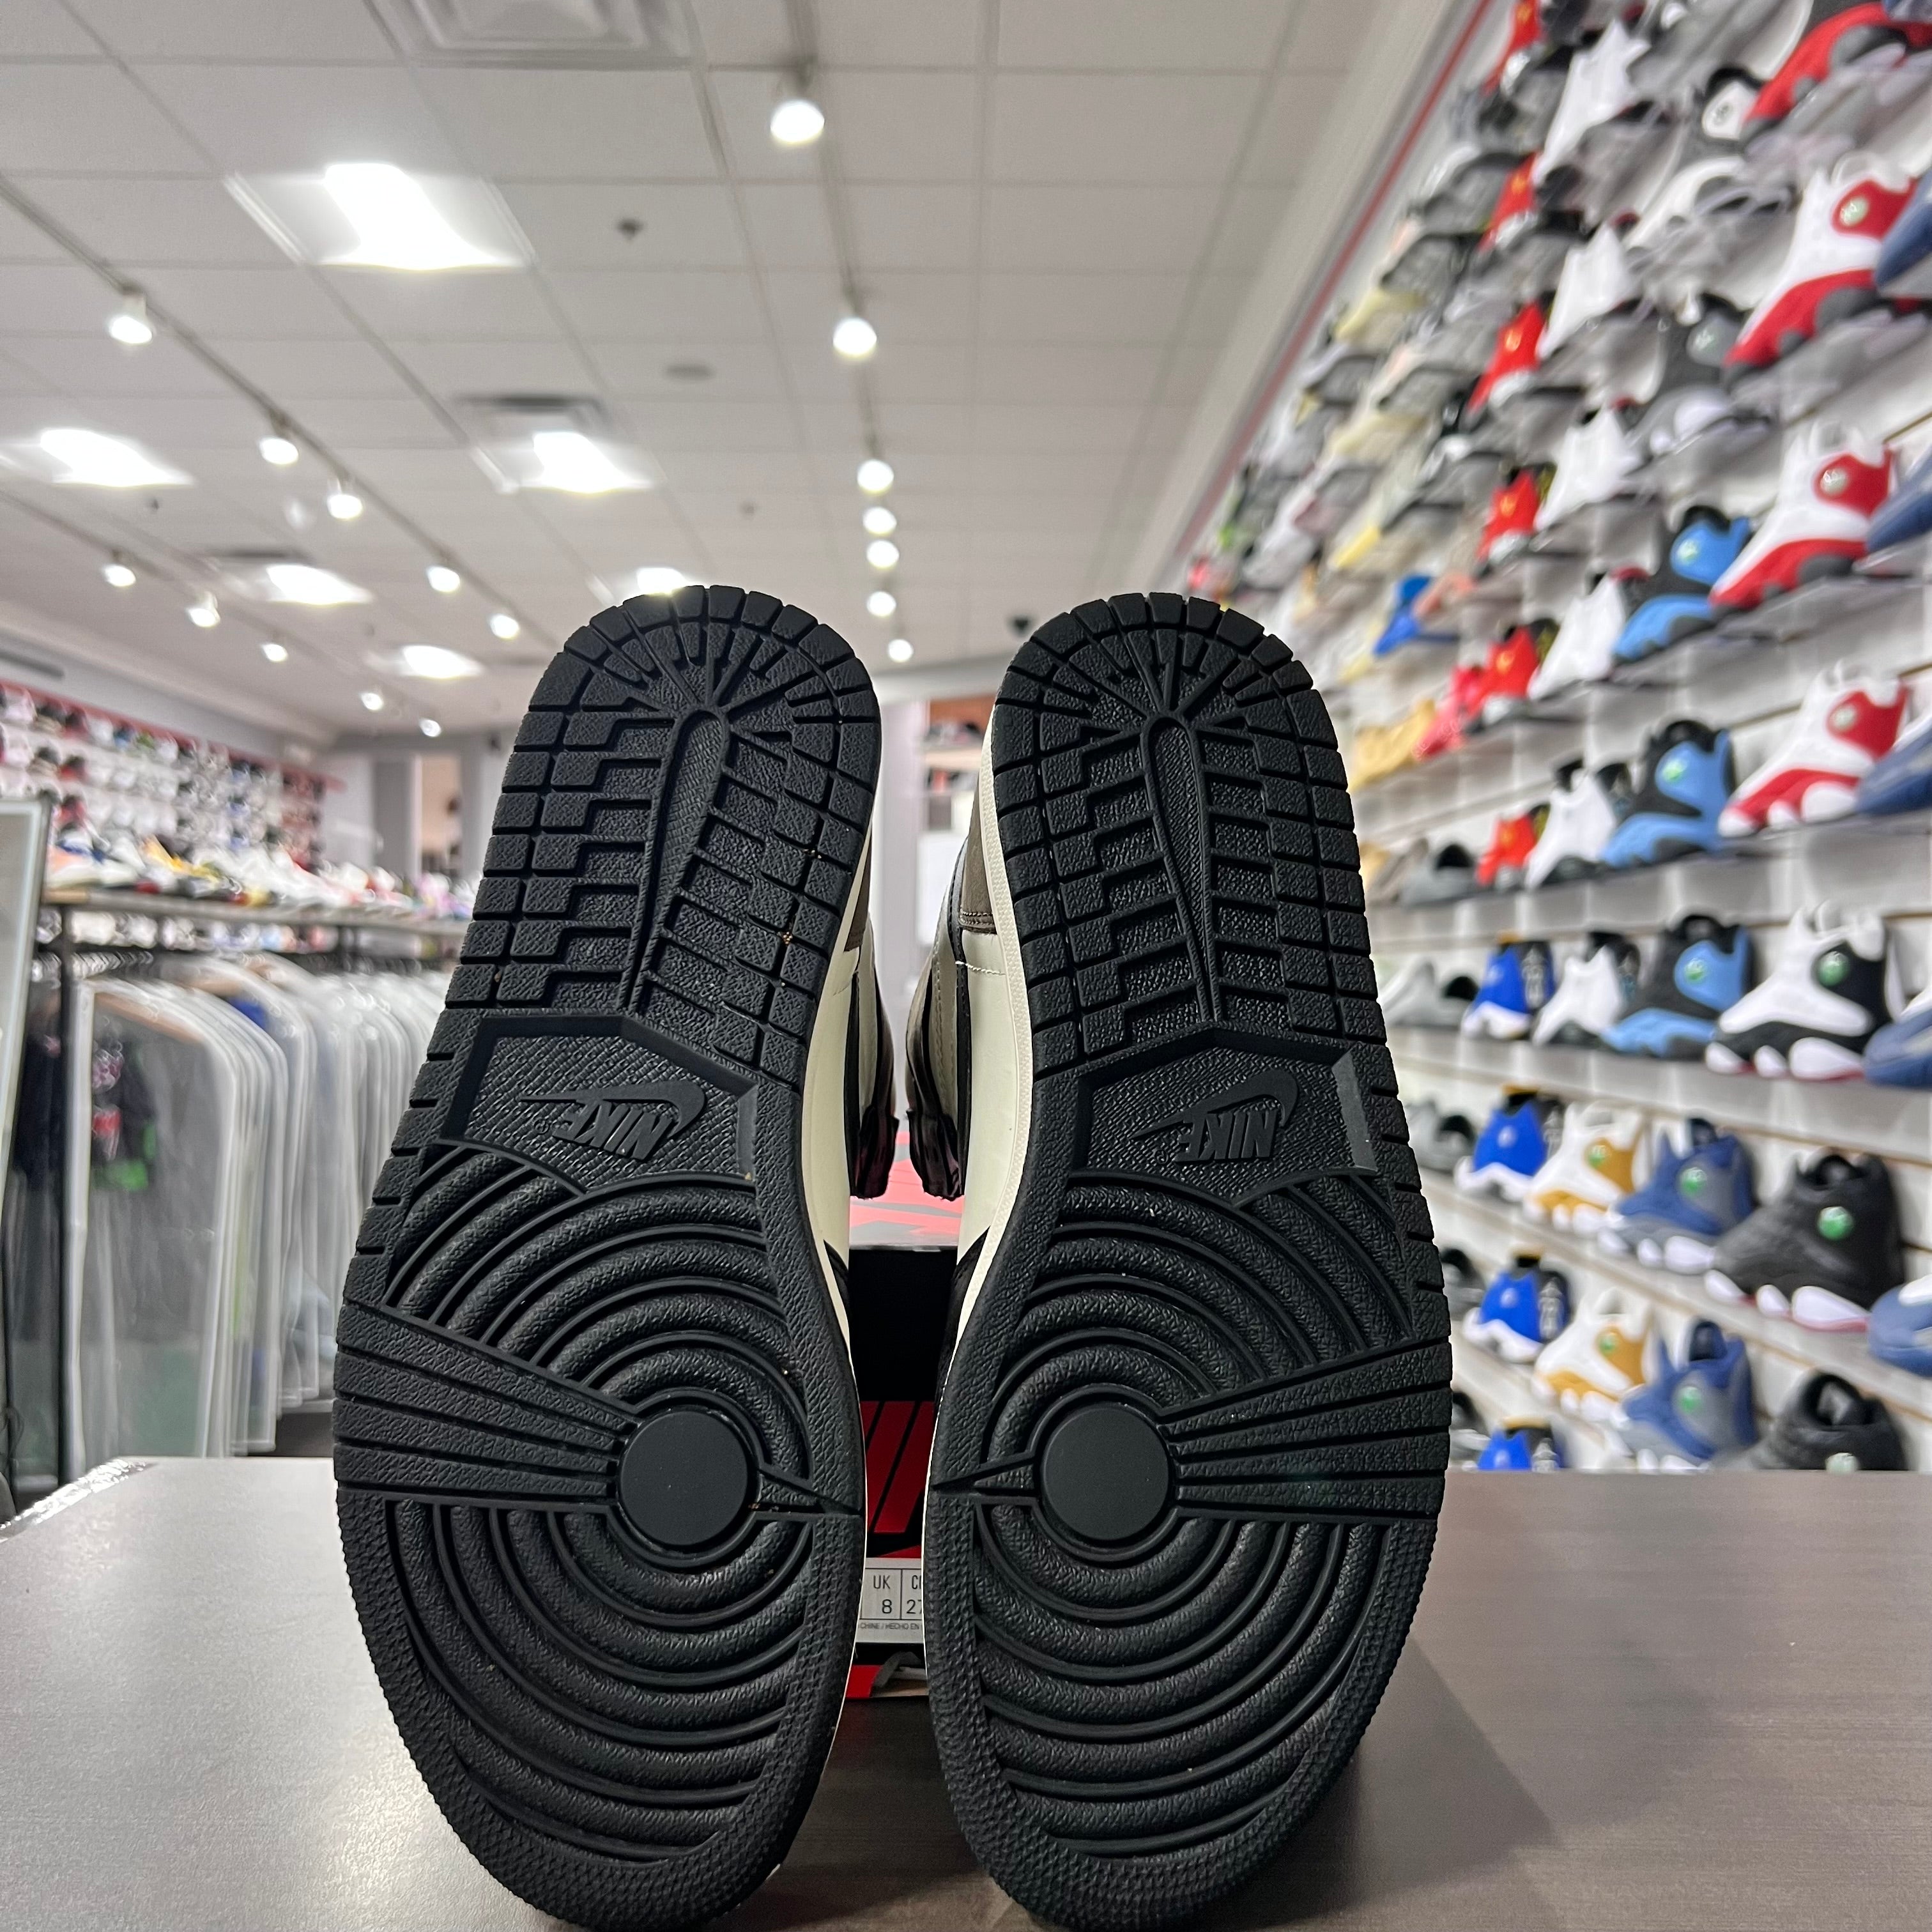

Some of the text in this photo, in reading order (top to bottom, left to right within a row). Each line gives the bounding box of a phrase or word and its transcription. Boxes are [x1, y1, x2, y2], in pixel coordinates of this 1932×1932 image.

[551, 1098, 673, 1160] NIKE
[1174, 1110, 1278, 1162] NIKE
[873, 1574, 922, 1590] UK C
[882, 1598, 893, 1614] 8
